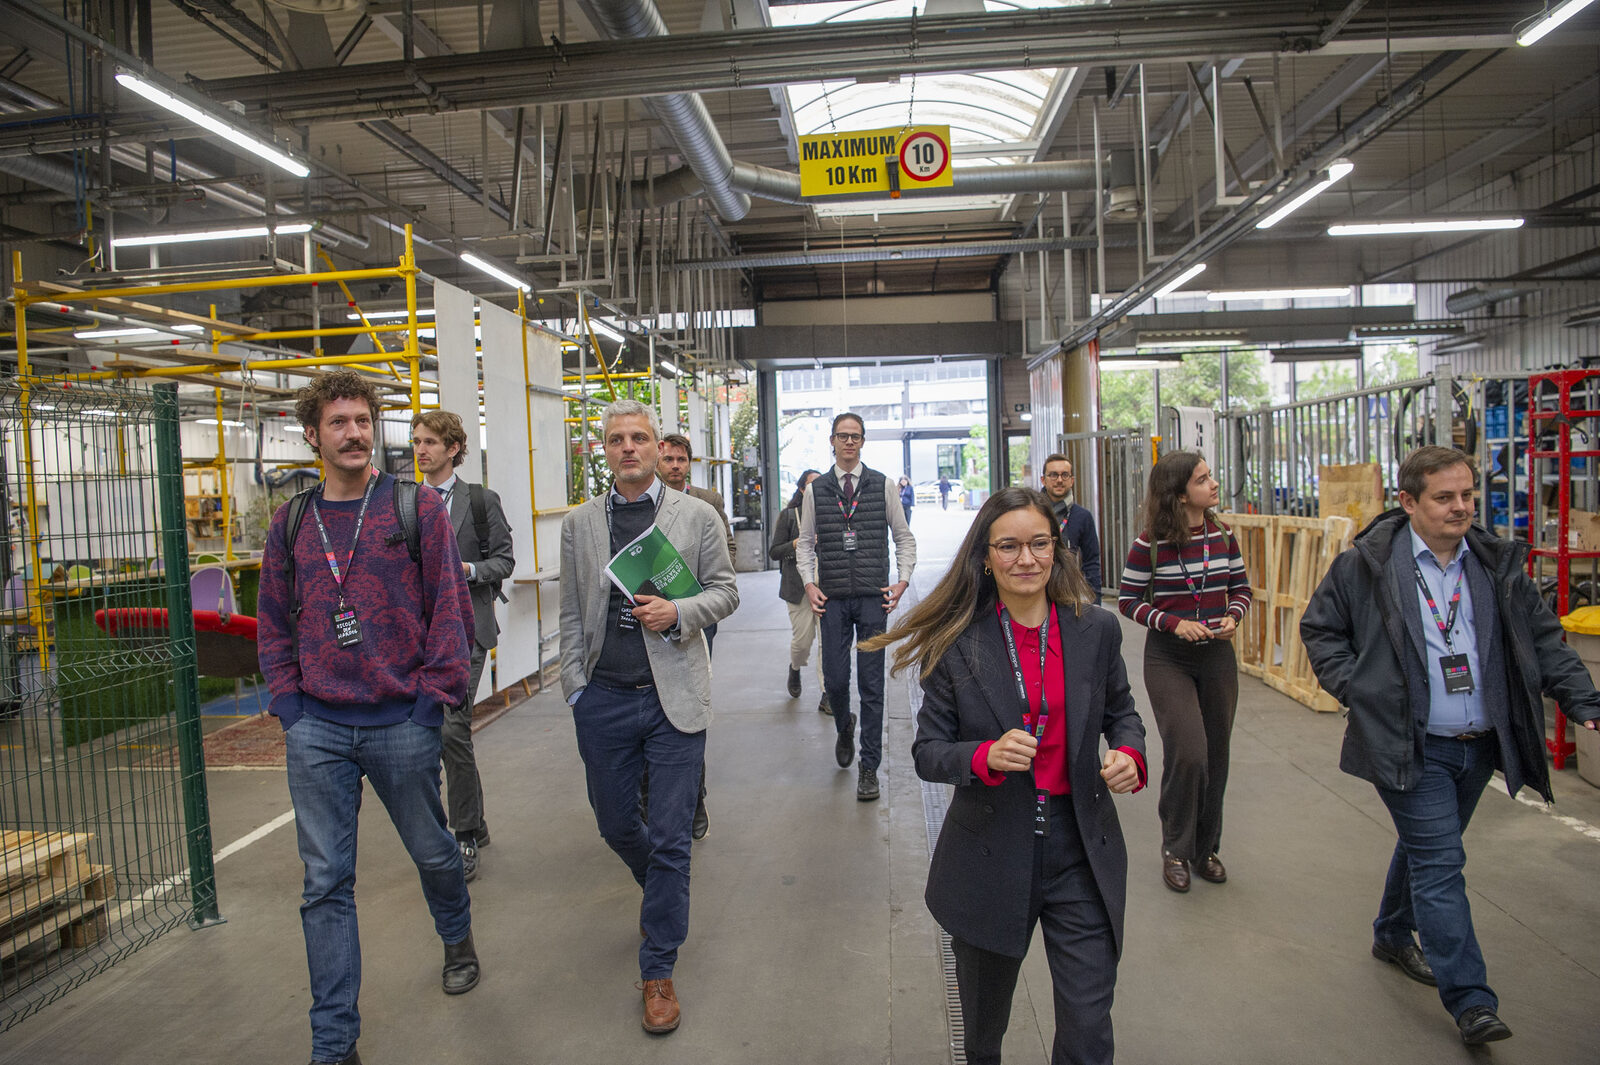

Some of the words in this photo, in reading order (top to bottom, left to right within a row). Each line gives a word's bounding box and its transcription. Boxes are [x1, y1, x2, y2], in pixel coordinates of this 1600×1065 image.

[802, 135, 896, 161] MAXIMUM
[912, 143, 935, 165] 10
[826, 166, 845, 186] 10
[849, 165, 877, 184] Km
